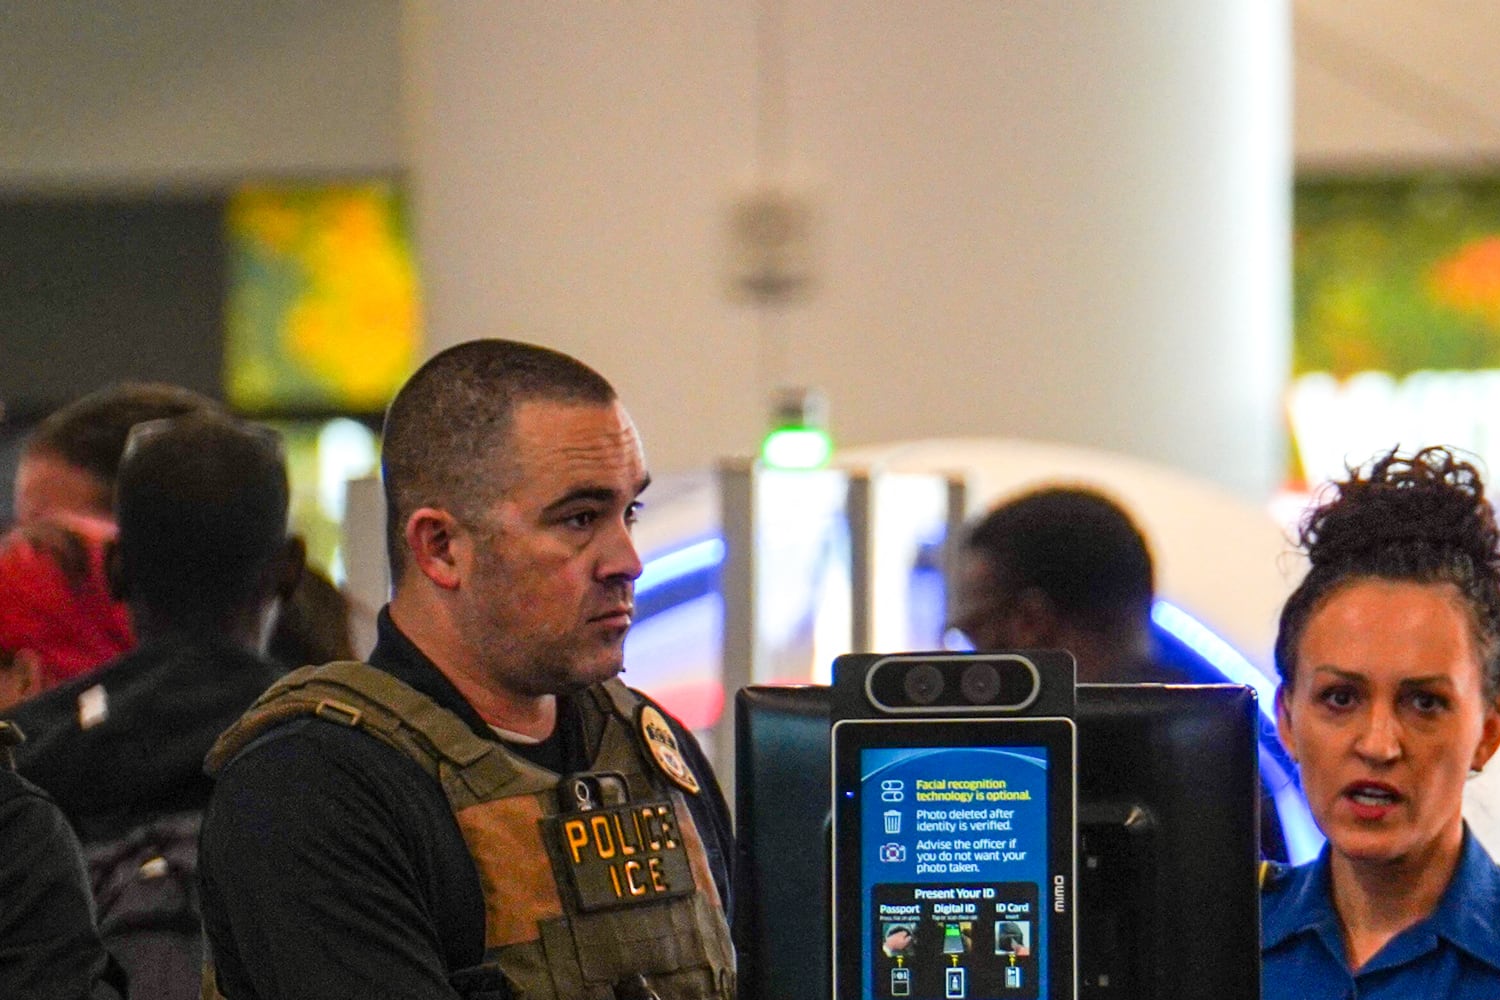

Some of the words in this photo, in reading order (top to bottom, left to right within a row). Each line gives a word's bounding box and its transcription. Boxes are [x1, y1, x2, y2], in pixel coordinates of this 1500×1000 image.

[916, 779, 946, 789] Facial
[948, 779, 1006, 791] recognition
[916, 791, 973, 802] technology
[975, 790, 984, 800] is
[986, 790, 1031, 802] optional.
[916, 809, 947, 819] Photo
[949, 809, 987, 819] deleted
[989, 808, 1014, 819] after
[916, 821, 955, 832] identity
[958, 821, 967, 831] is
[969, 820, 1012, 831] verified.
[565, 807, 676, 863] POLICE
[916, 839, 951, 850] Advise
[954, 839, 971, 849] the
[973, 838, 1006, 849] officer
[1009, 838, 1017, 848] if
[916, 852, 936, 863] you
[938, 851, 952, 861] do
[954, 851, 971, 861] not
[974, 851, 1000, 861] want
[1002, 852, 1027, 862] your
[916, 863, 947, 874] photo
[949, 862, 980, 873] taken.
[609, 858, 666, 897] ICE
[915, 888, 954, 899] Present
[956, 888, 981, 899] Your
[983, 888, 995, 898] ID
[879, 904, 920, 915] Passport
[933, 903, 962, 915] Digital
[964, 903, 975, 913] ID
[995, 903, 1006, 912] ID
[1007, 903, 1029, 912] Card
